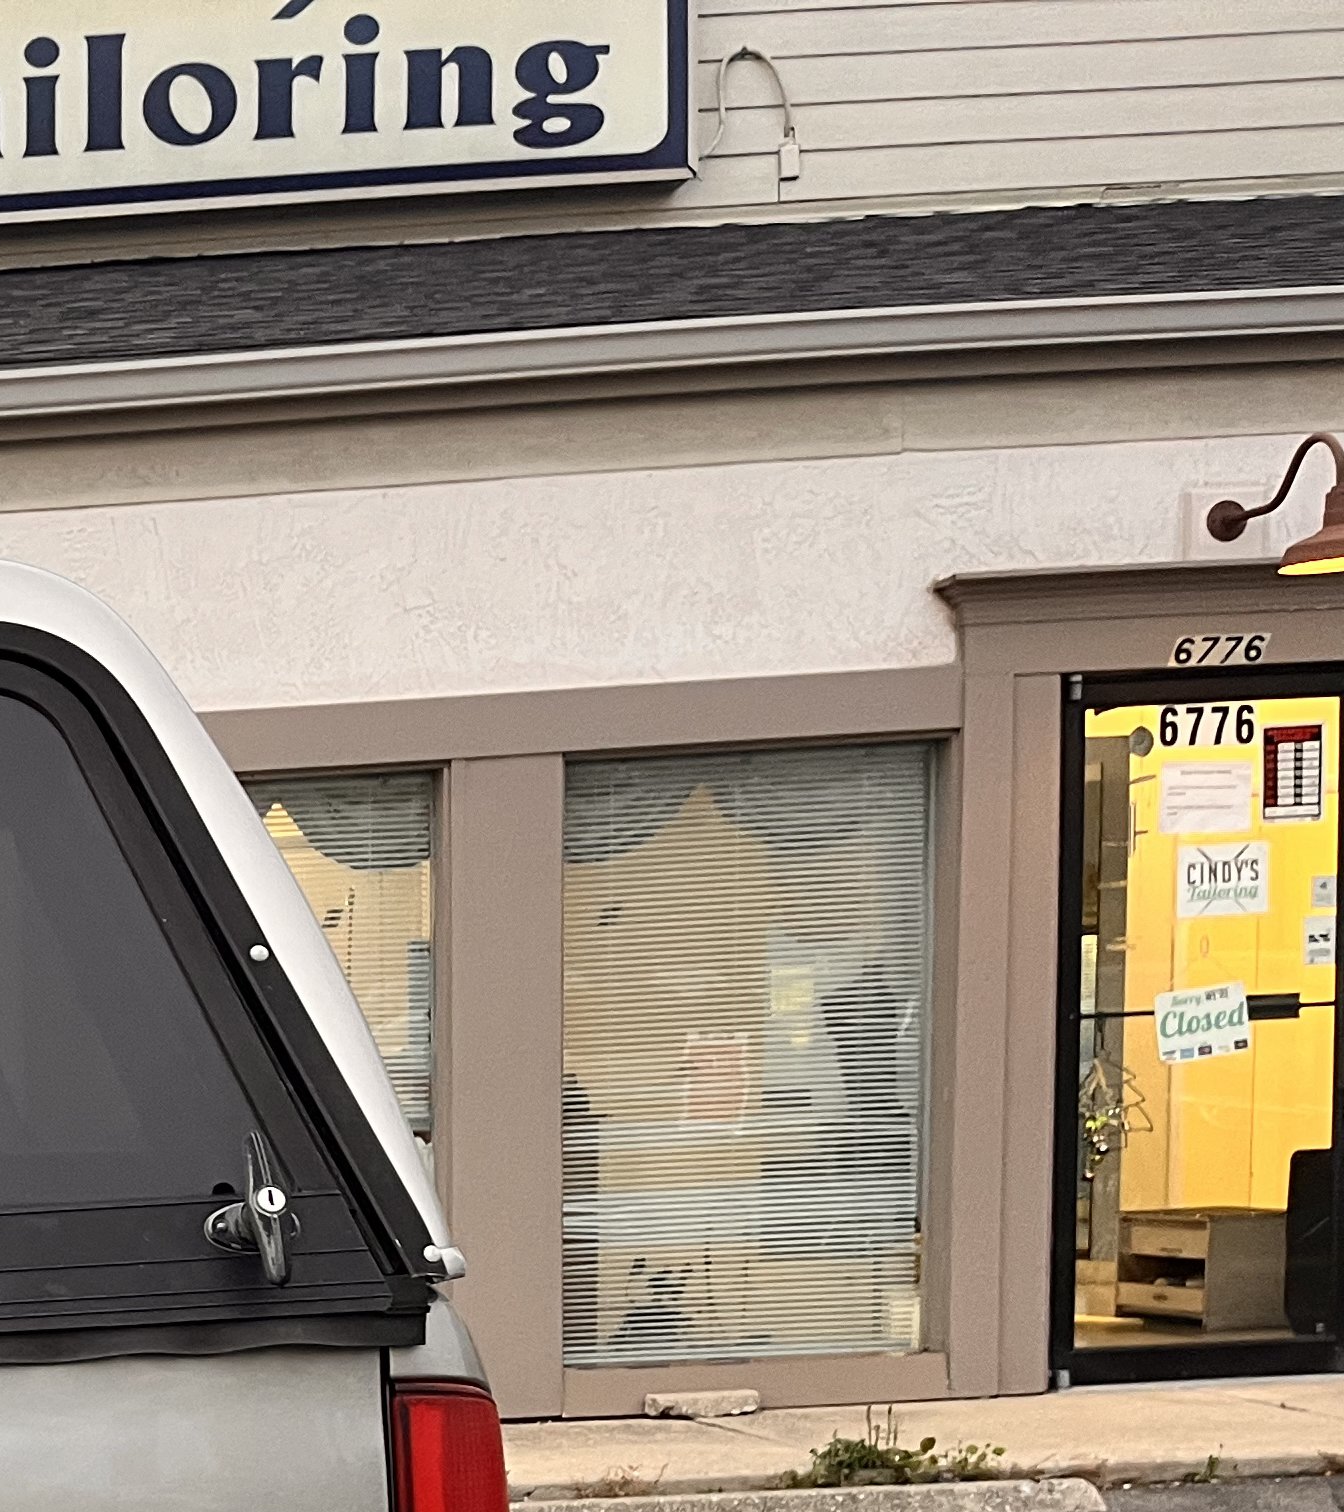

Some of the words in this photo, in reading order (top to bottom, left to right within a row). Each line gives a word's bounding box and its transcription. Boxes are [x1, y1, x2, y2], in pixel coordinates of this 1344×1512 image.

[1174, 635, 1265, 664] 6776
[1159, 704, 1255, 747] 6776
[1186, 858, 1260, 886] CINDY'S
[1185, 884, 1260, 903] Tailoring
[1159, 1001, 1245, 1039] Closed
